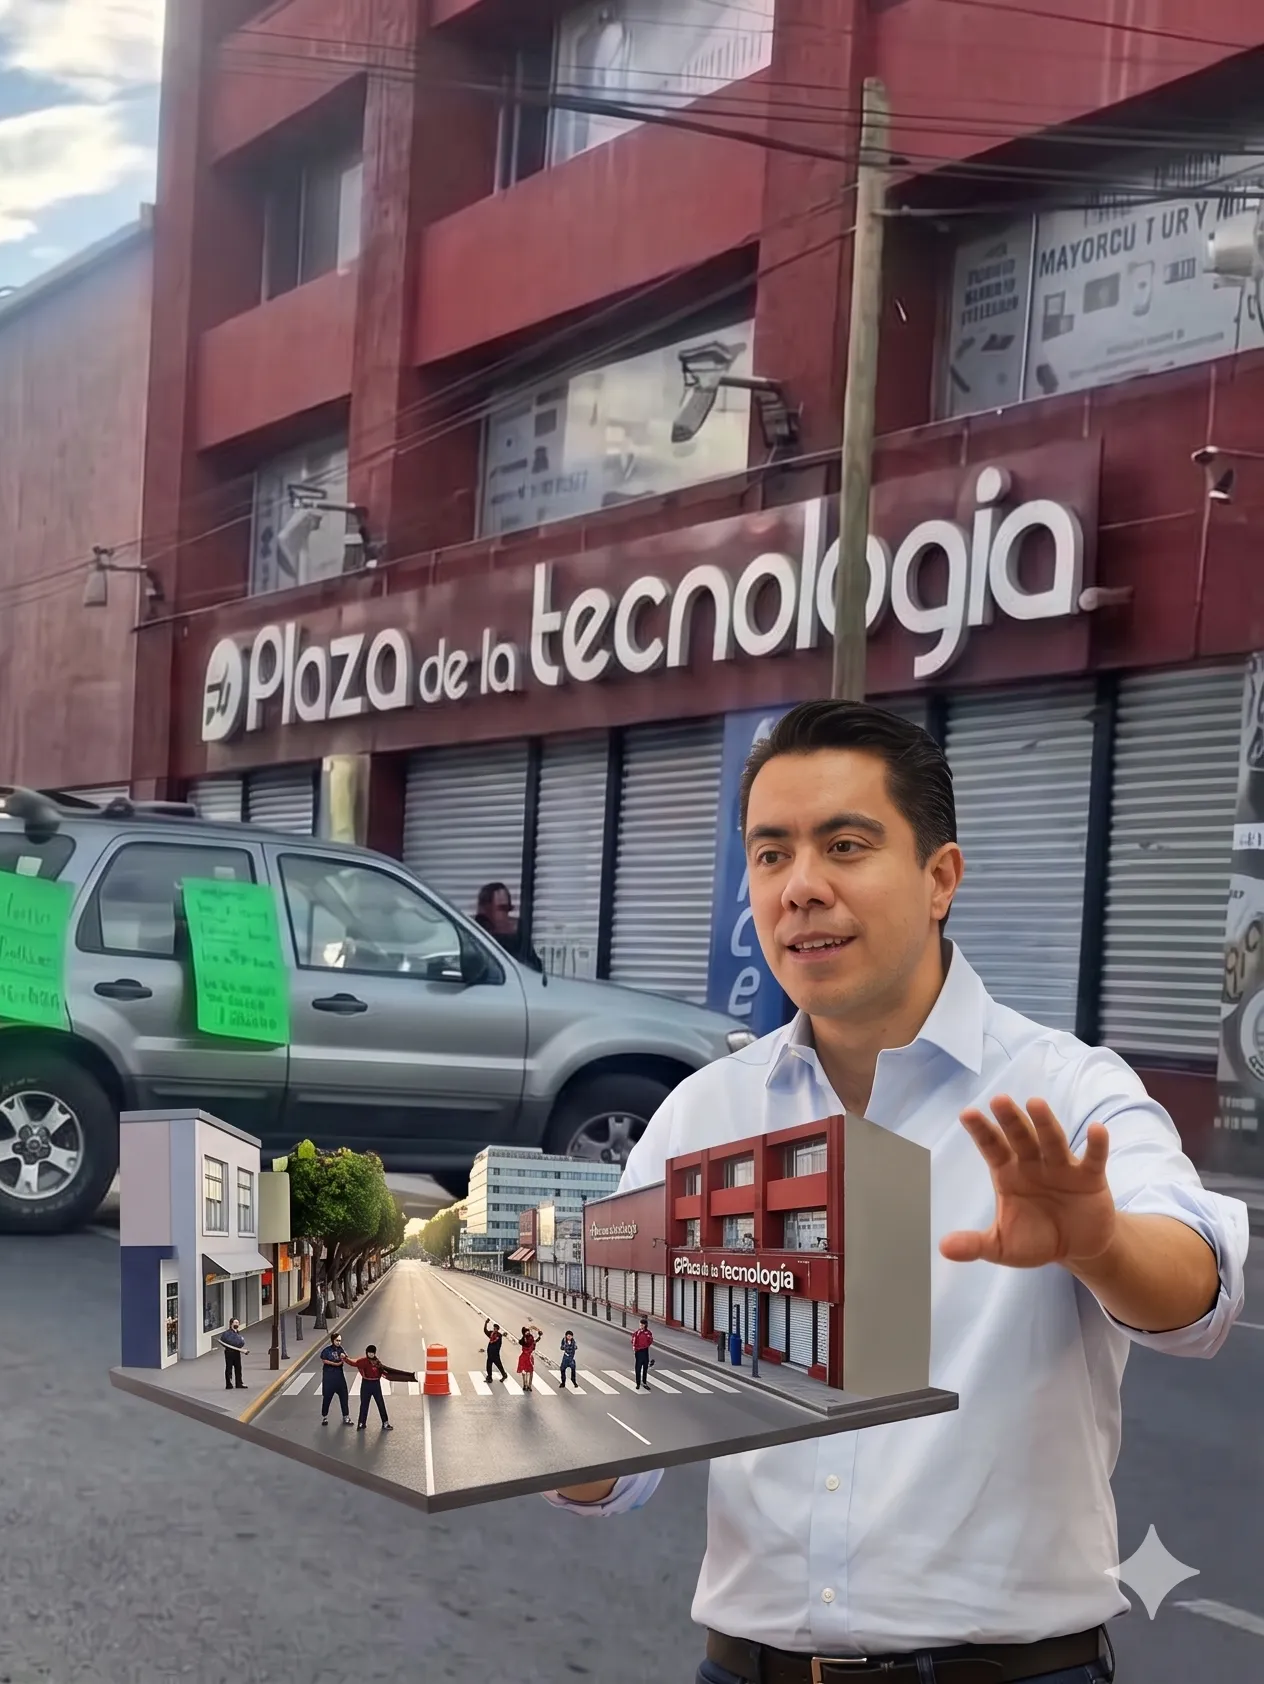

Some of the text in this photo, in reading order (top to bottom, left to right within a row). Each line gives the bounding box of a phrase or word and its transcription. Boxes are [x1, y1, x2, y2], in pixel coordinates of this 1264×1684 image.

[246, 621, 412, 732] Plaza
[419, 638, 470, 704] de
[480, 627, 520, 695] la
